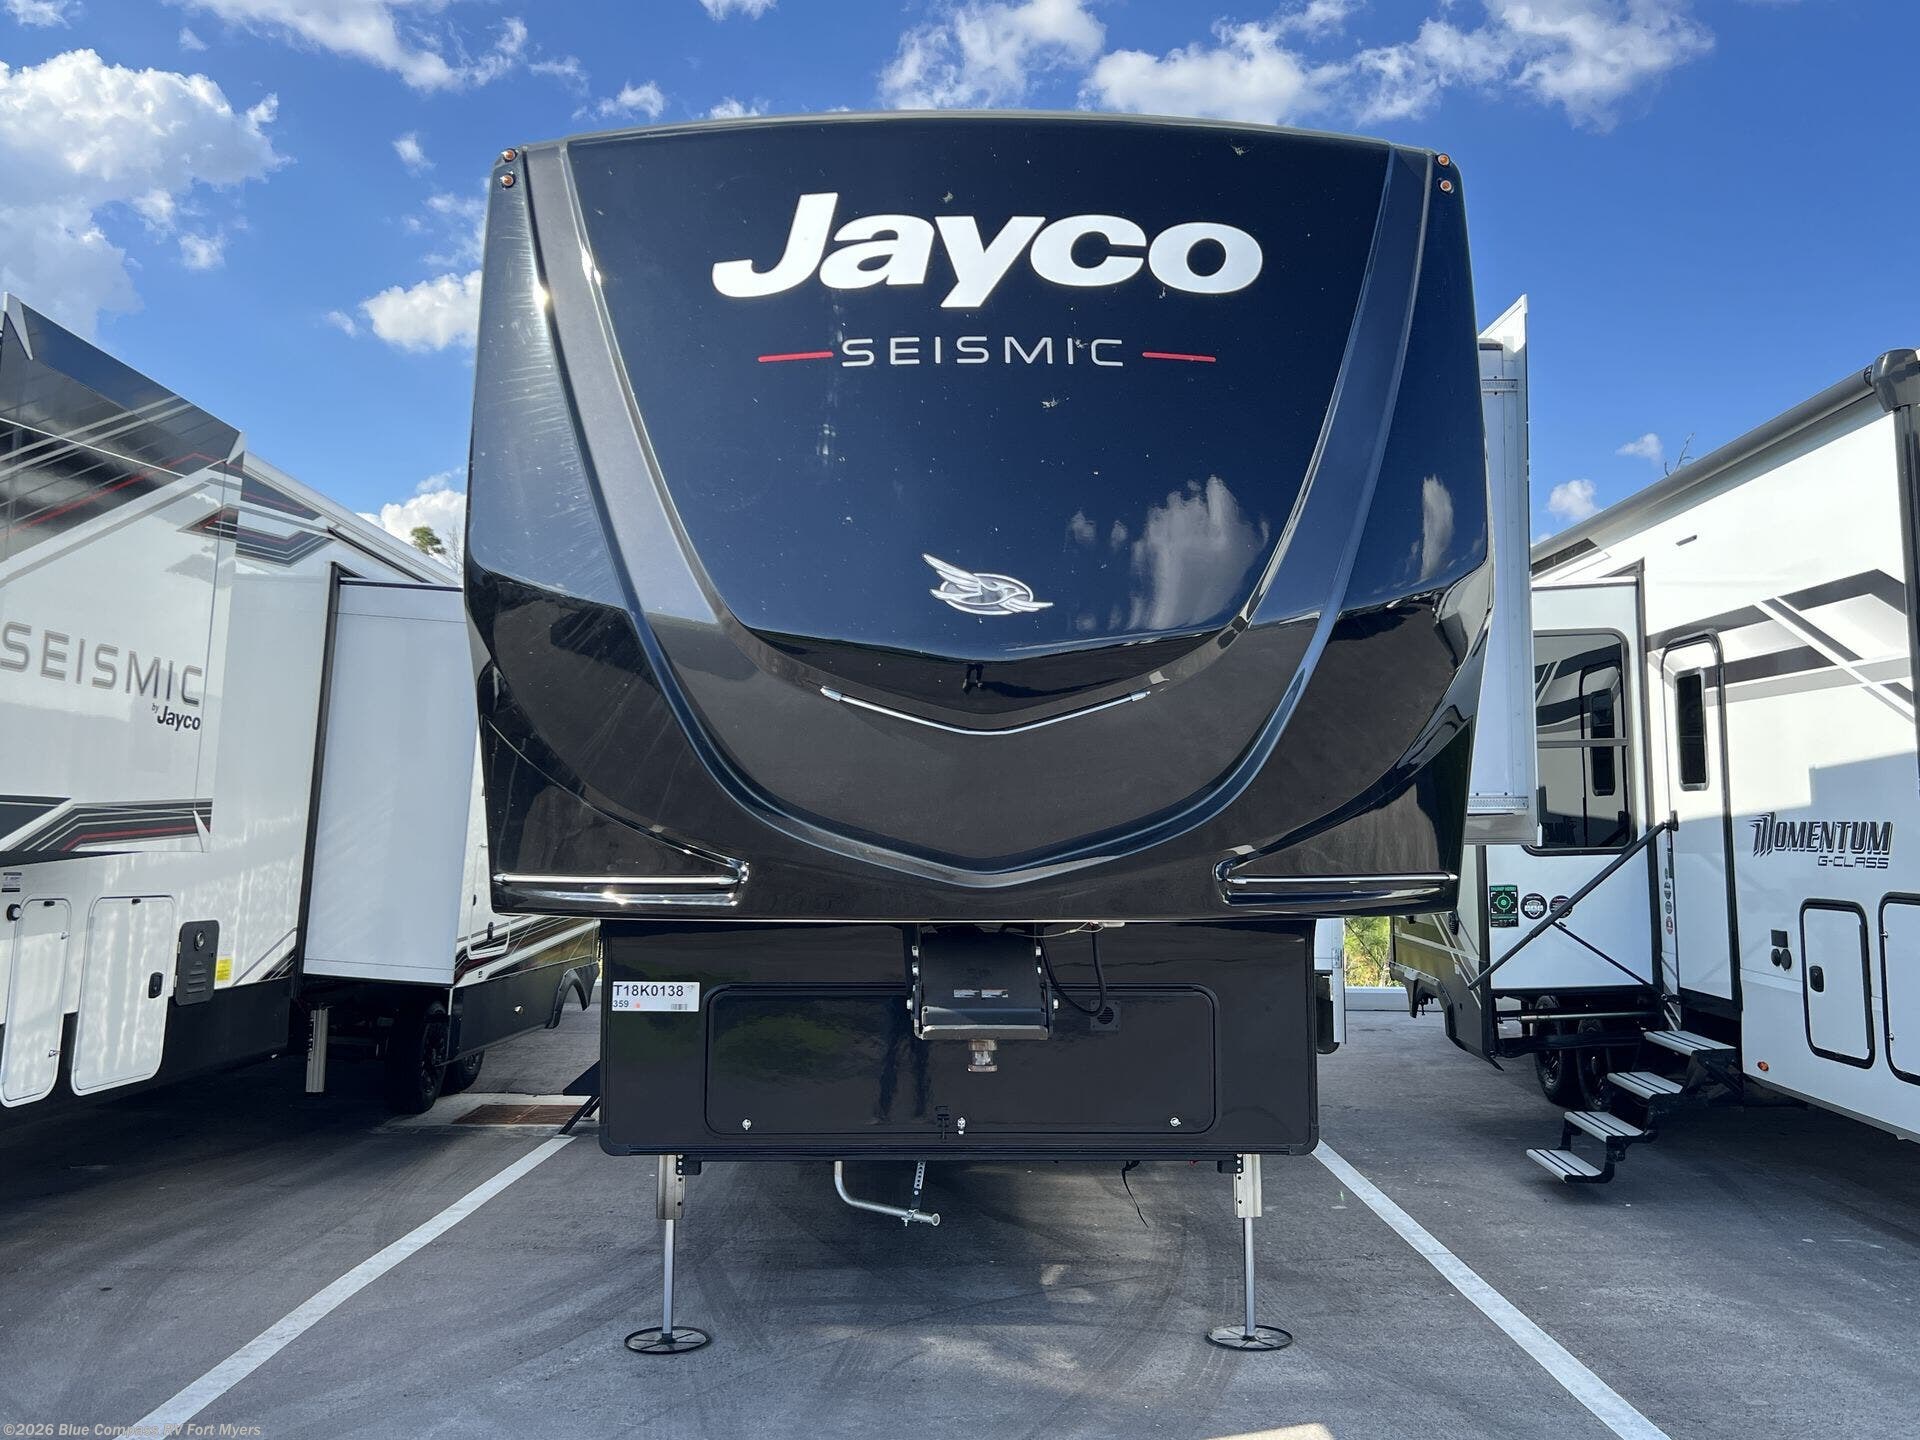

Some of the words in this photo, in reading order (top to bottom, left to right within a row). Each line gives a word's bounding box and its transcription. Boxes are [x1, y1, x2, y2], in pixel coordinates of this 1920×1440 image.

[712, 192, 1263, 308] Jayco
[840, 336, 1124, 367] SEISMIC
[0, 621, 203, 707] SEISMIC
[151, 702, 160, 714] by
[157, 705, 201, 731] Jayco
[1748, 811, 1894, 858] MOMENTUM
[1817, 855, 1889, 869] G-CLASS
[613, 984, 684, 997] T18K0138
[613, 1000, 629, 1008] 359
